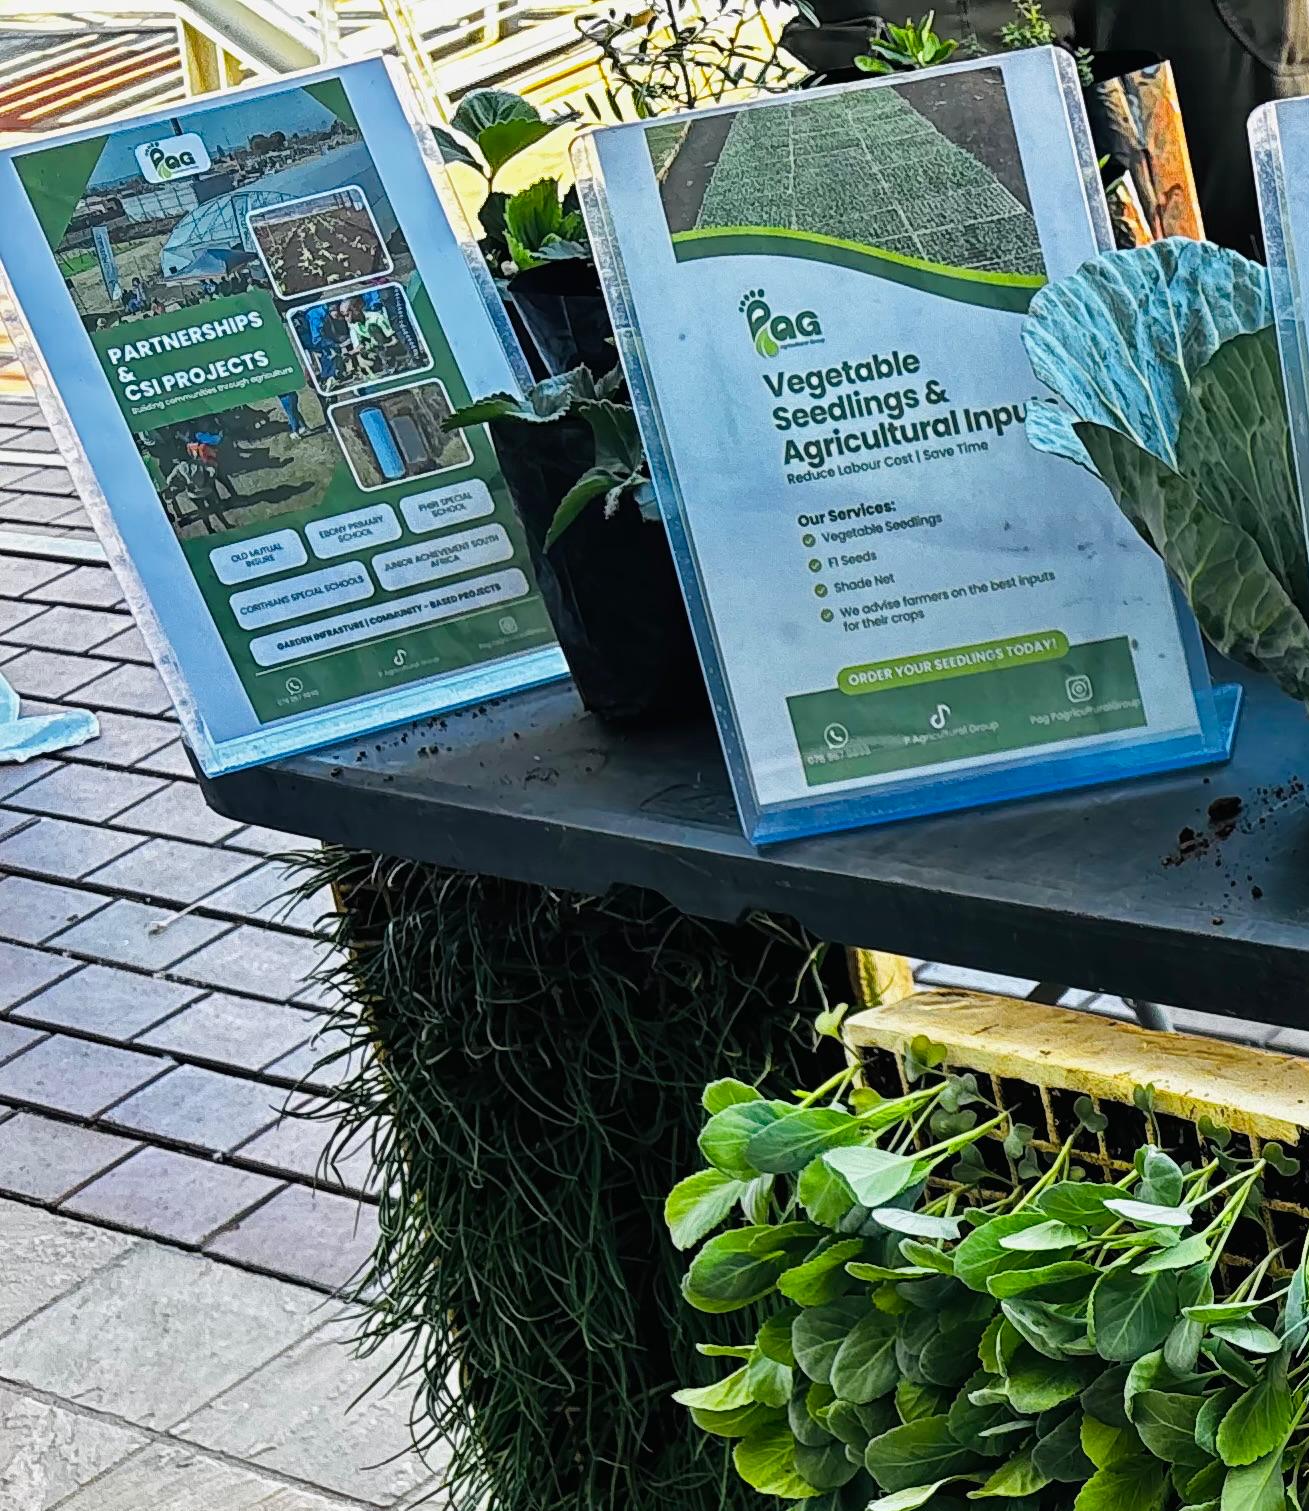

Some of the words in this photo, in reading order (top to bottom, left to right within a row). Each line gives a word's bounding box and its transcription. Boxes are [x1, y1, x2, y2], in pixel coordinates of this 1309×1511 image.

[107, 310, 264, 366] PARTNERSHIPS
[117, 366, 137, 384] &
[124, 380, 162, 402] CSI
[161, 350, 270, 393] PROJECTS
[165, 386, 219, 406] communities
[217, 377, 250, 393] through
[250, 366, 294, 385] agriculture
[763, 351, 920, 399] Vegetable
[772, 388, 920, 431] Seedlings
[925, 379, 950, 405] &
[783, 409, 961, 469] Agricultural
[786, 467, 836, 486] Reduce
[837, 458, 882, 476] Labour
[883, 452, 914, 468] Cost
[922, 447, 954, 461] Save
[955, 440, 989, 455] Time
[797, 512, 826, 528] Our
[828, 500, 897, 523] Services:
[820, 523, 883, 544] Vegetable
[884, 512, 943, 532] Seedlings
[230, 551, 249, 563] OLD
[840, 550, 877, 566] Seeds
[369, 603, 423, 625] COMMUNITY
[429, 594, 458, 609] BASED
[458, 583, 502, 601] PROJECTS
[833, 577, 873, 593] Shade
[873, 573, 896, 587] Net
[839, 605, 860, 618] We
[861, 599, 901, 615] advise
[902, 590, 950, 607] farmers
[950, 586, 967, 599] on
[968, 582, 989, 596] the
[989, 578, 1017, 592] best
[1018, 570, 1056, 588] inputs
[843, 617, 861, 633] for
[861, 615, 889, 629] their
[890, 609, 925, 624] crops
[847, 665, 893, 687] ORDER
[893, 660, 934, 679] YOUR
[934, 647, 1004, 672] SEEDLINGS
[1004, 637, 1058, 658] TODAY!
